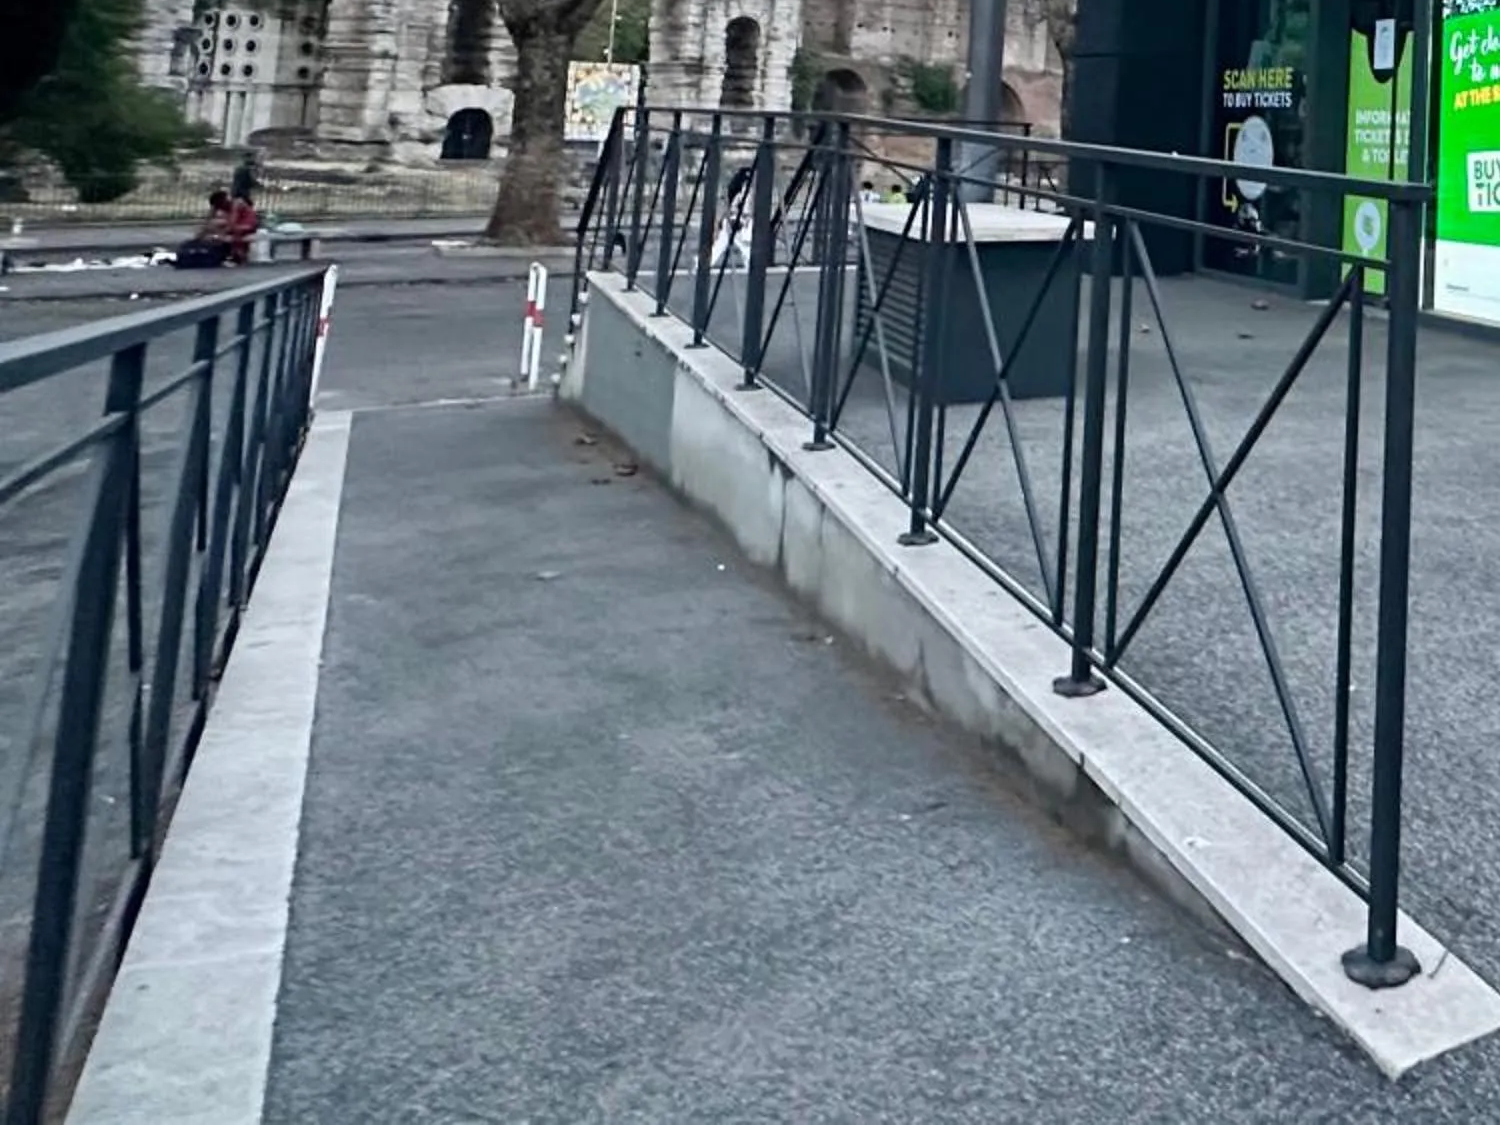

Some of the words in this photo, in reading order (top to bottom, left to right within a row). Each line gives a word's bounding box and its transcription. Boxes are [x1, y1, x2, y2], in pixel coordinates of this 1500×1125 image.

[1450, 28, 1480, 76] Get
[1223, 68, 1256, 91] SCAN
[1259, 66, 1294, 89] HERE
[1469, 56, 1486, 83] to
[1223, 92, 1234, 107] TO
[1235, 92, 1252, 107] BUY
[1254, 92, 1293, 107] TICKETS
[1454, 90, 1469, 112] AT
[1470, 85, 1491, 106] THE
